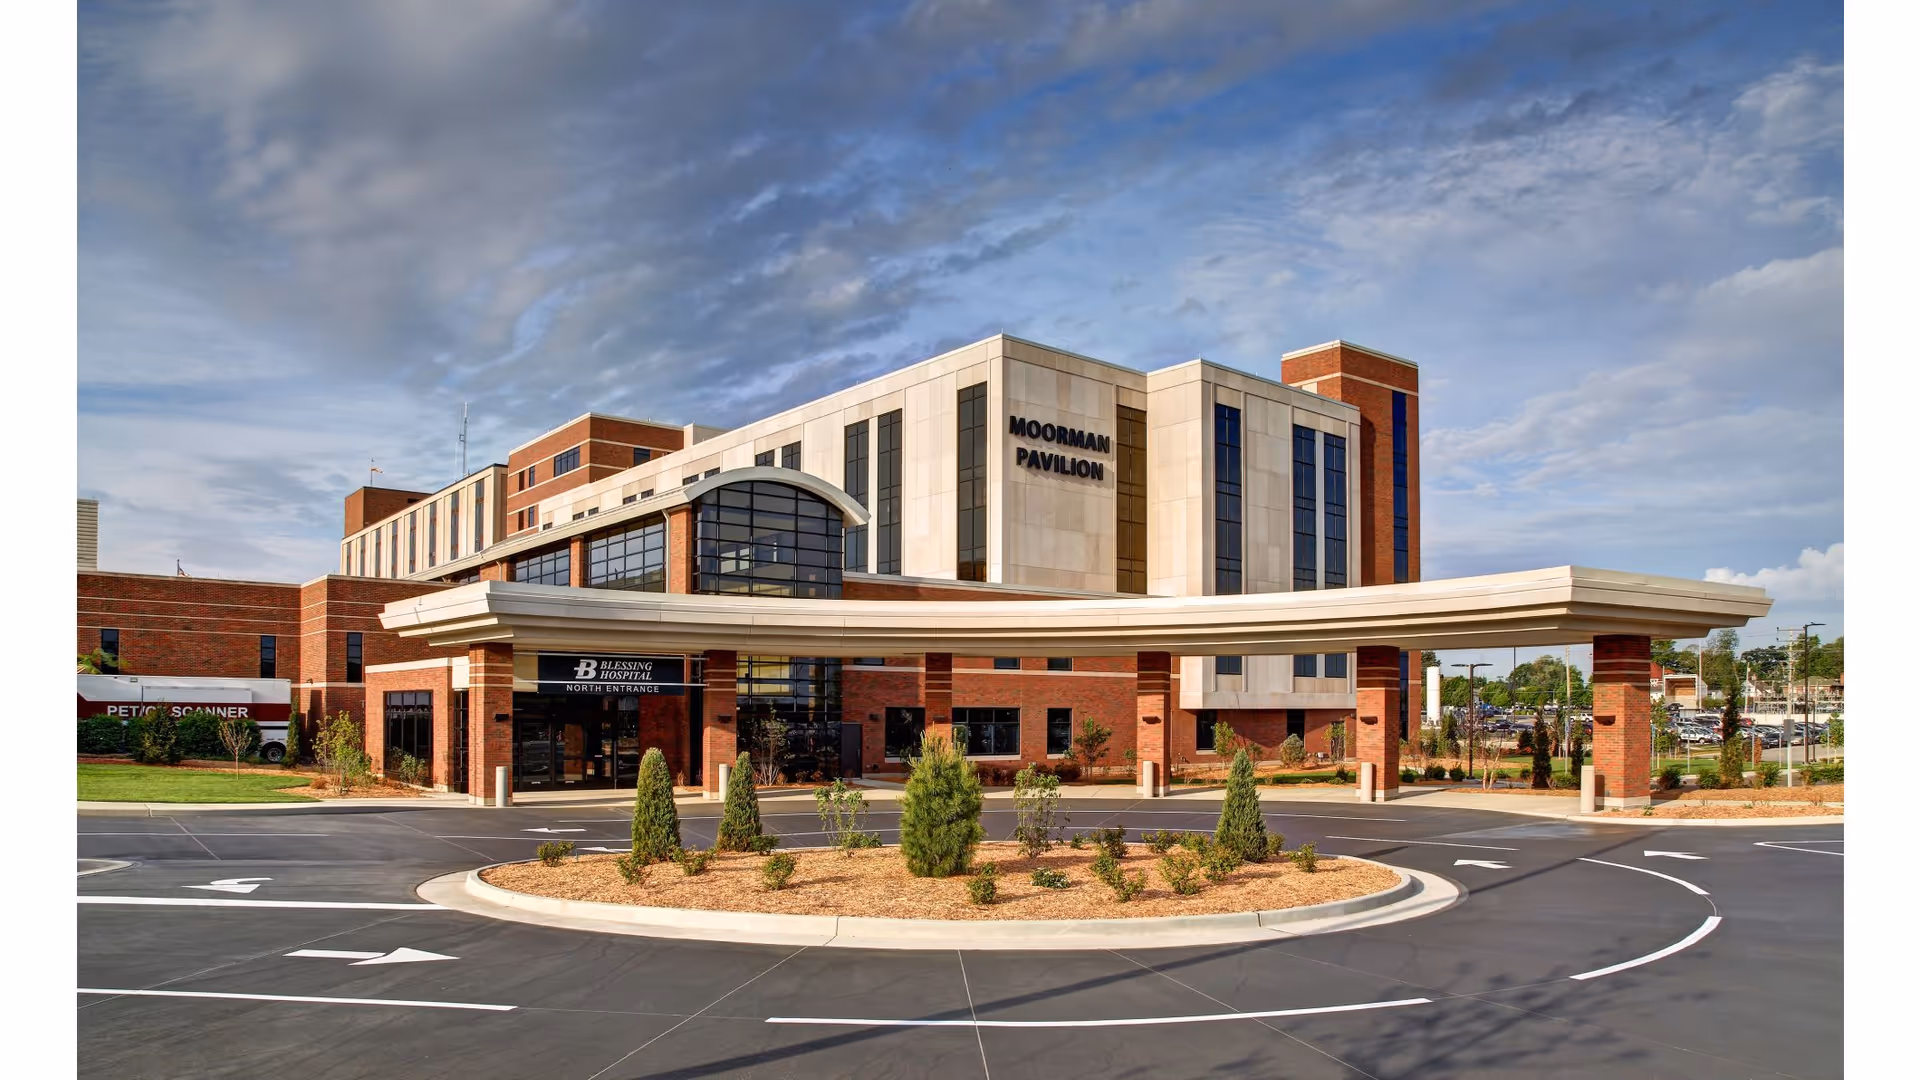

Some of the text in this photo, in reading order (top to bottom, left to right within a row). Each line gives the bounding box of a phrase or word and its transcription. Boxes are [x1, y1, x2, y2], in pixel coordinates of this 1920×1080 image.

[1009, 416, 1110, 453] MOORMAN
[1016, 447, 1104, 480] PAVILION
[600, 661, 652, 671] BLESSING
[600, 671, 652, 680] HOSPITAL
[566, 684, 659, 693] NORTH ENTRANCE
